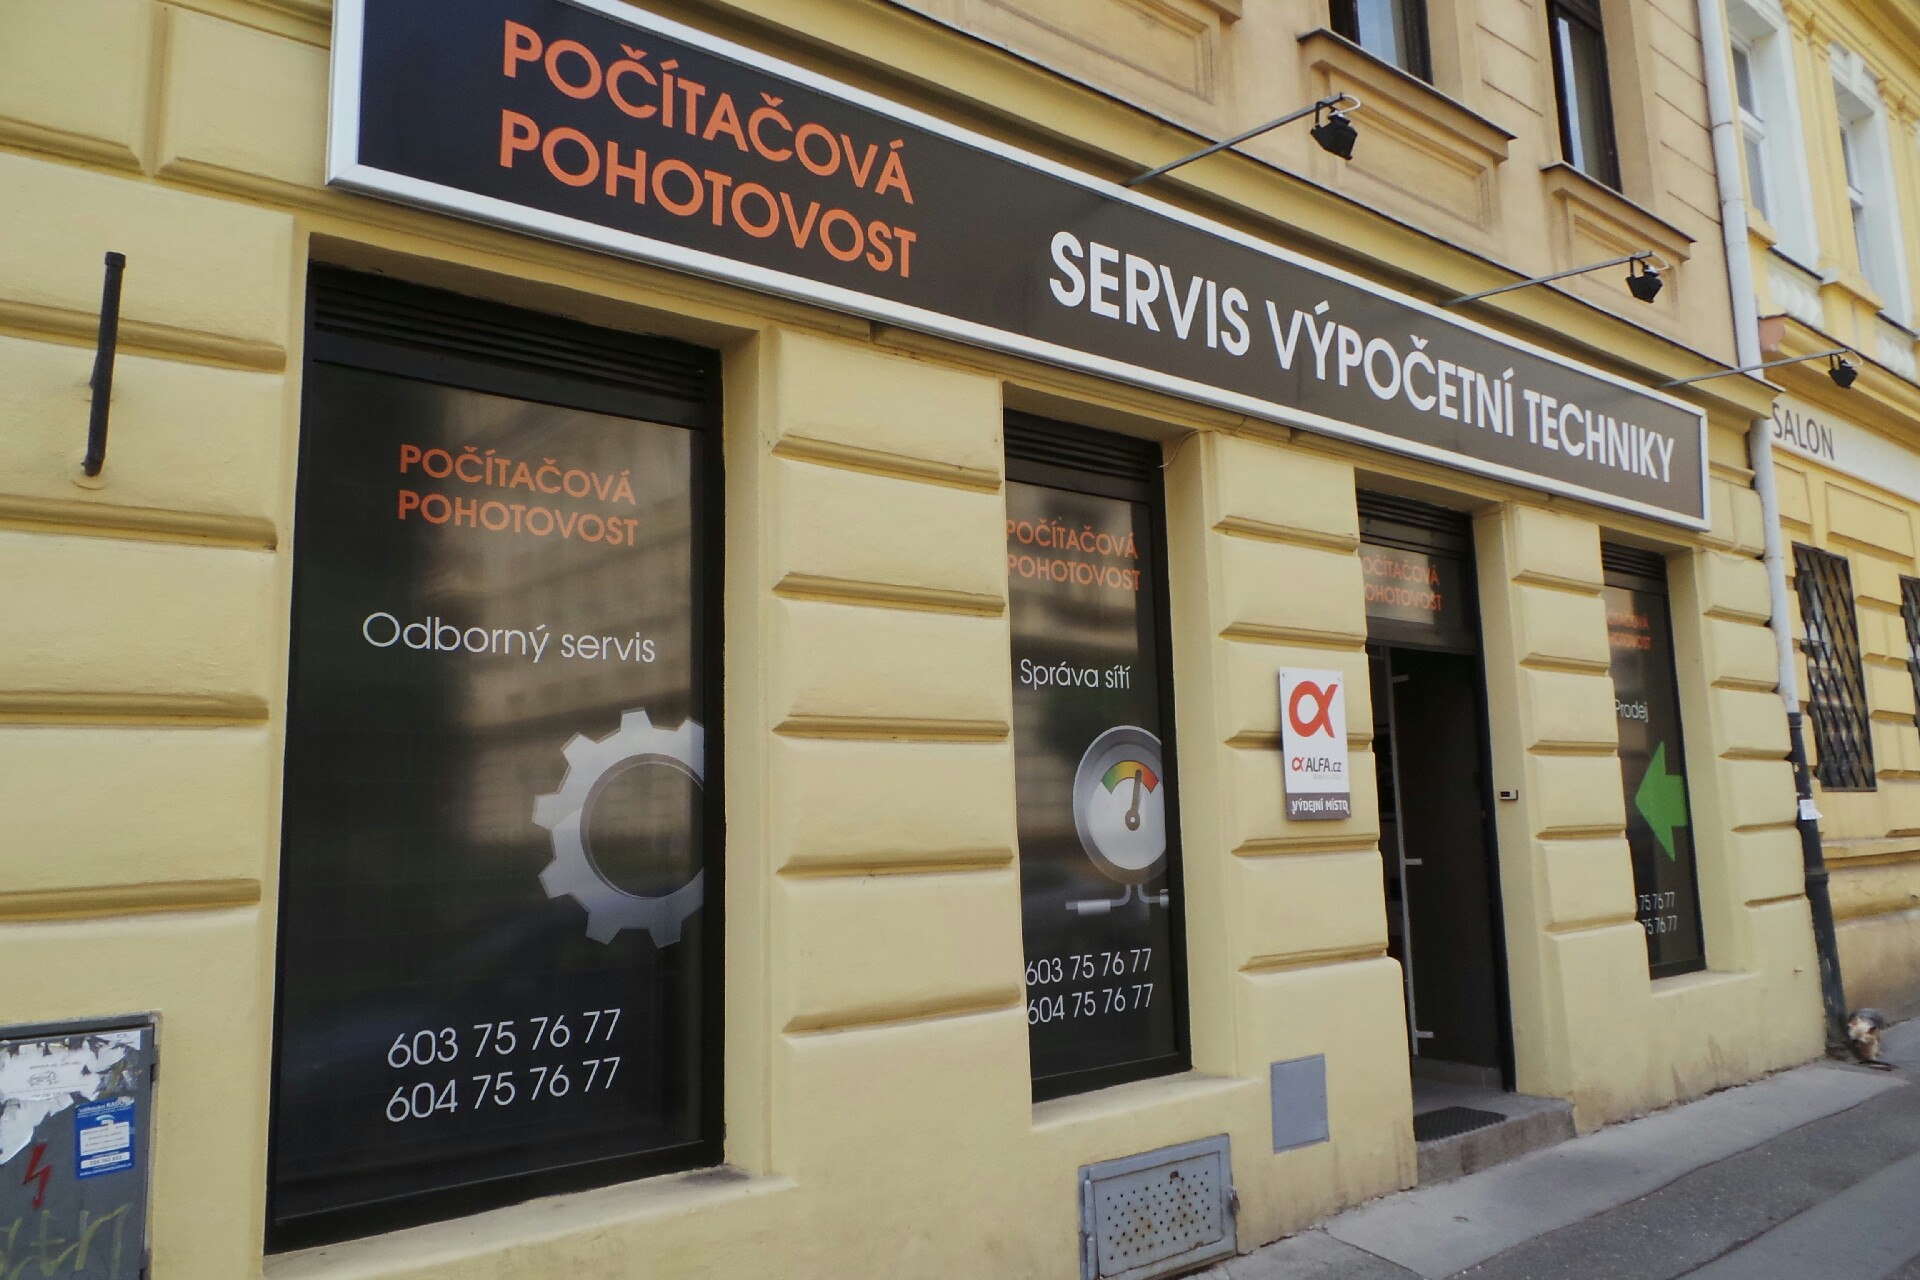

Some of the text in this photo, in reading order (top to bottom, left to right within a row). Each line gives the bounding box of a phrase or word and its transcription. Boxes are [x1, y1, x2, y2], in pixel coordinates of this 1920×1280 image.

[503, 19, 914, 205] POČÍTAČOVÁ
[500, 108, 917, 279] POHOTOVOST
[1049, 231, 1675, 483] SERVIS VÝPOČETNÍ TECHNIKY
[1772, 402, 1835, 461] SALON
[400, 443, 637, 505] POČÍTAČOVÁ
[397, 489, 639, 547] POHOTOVOST
[1006, 518, 1139, 560] POČÍTAČOVÁ
[1008, 553, 1141, 591] POHOTOVOST
[1363, 555, 1440, 586] OČÍTAČOVÁ
[1365, 583, 1442, 611] OHOTOVOST
[362, 611, 656, 663] Odborný servis
[1020, 658, 1131, 690] Správa sítí
[1291, 797, 1349, 813] VÝDEJNÍ MÍSTO
[1639, 891, 1675, 911] 75 76 77
[1654, 916, 1666, 933] 76
[1667, 915, 1677, 931] 77
[1025, 948, 1152, 986] 603 75 76 77
[1027, 983, 1154, 1025] 604 75 76 77
[387, 1008, 621, 1069] 603 75 76 77
[385, 1056, 621, 1123] 604 75 76 77
